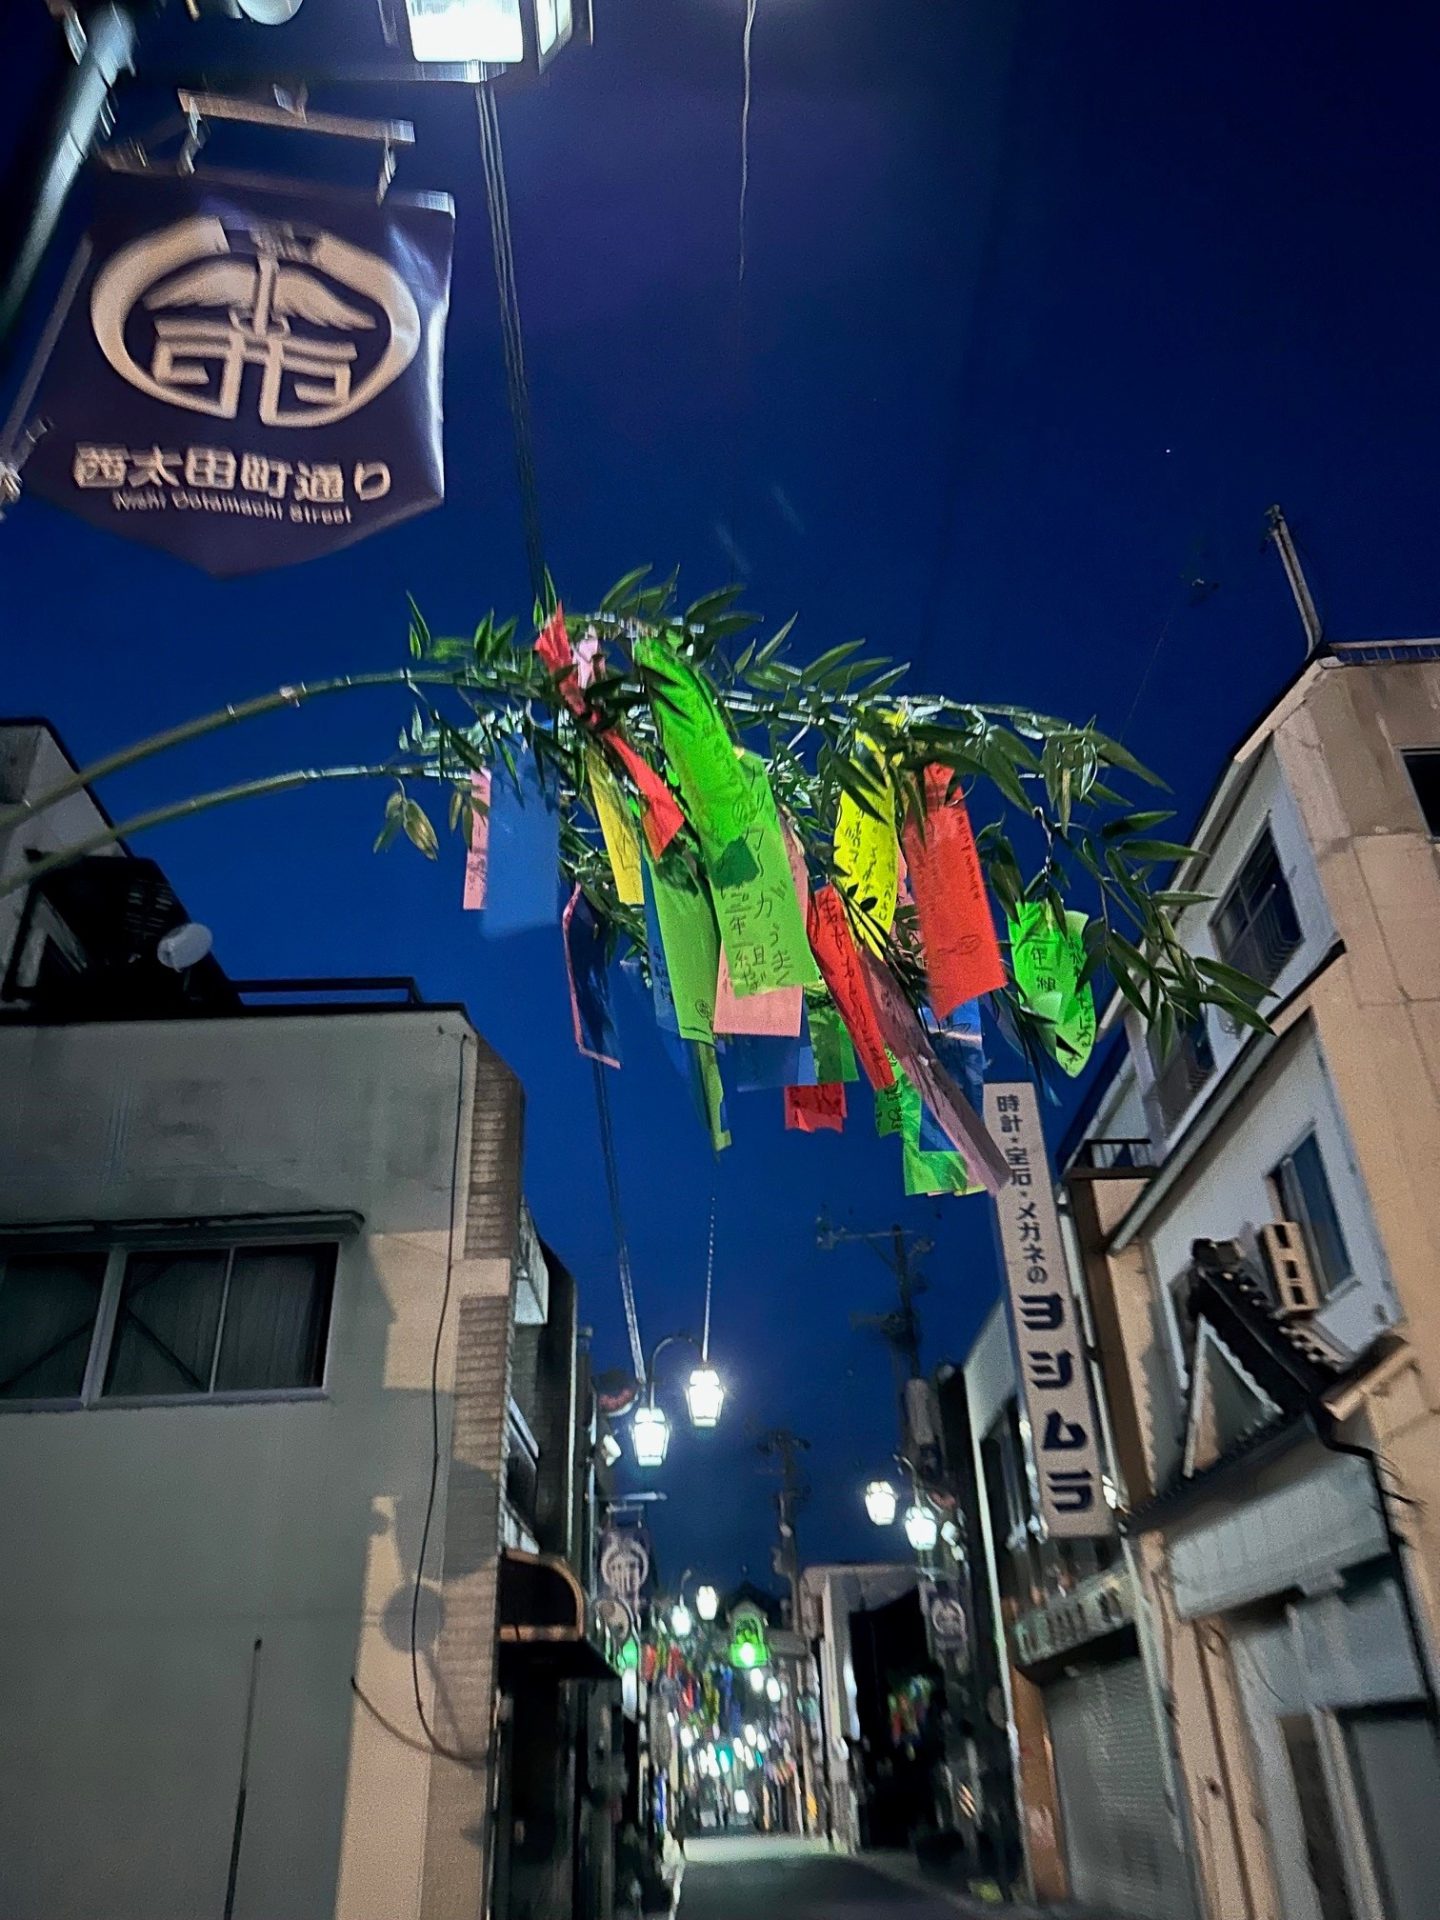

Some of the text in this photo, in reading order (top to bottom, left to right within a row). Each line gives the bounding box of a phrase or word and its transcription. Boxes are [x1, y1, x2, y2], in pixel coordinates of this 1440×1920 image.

[73, 442, 391, 502] 西太田町通り
[1018, 1292, 1095, 1513] ヨシムラ
